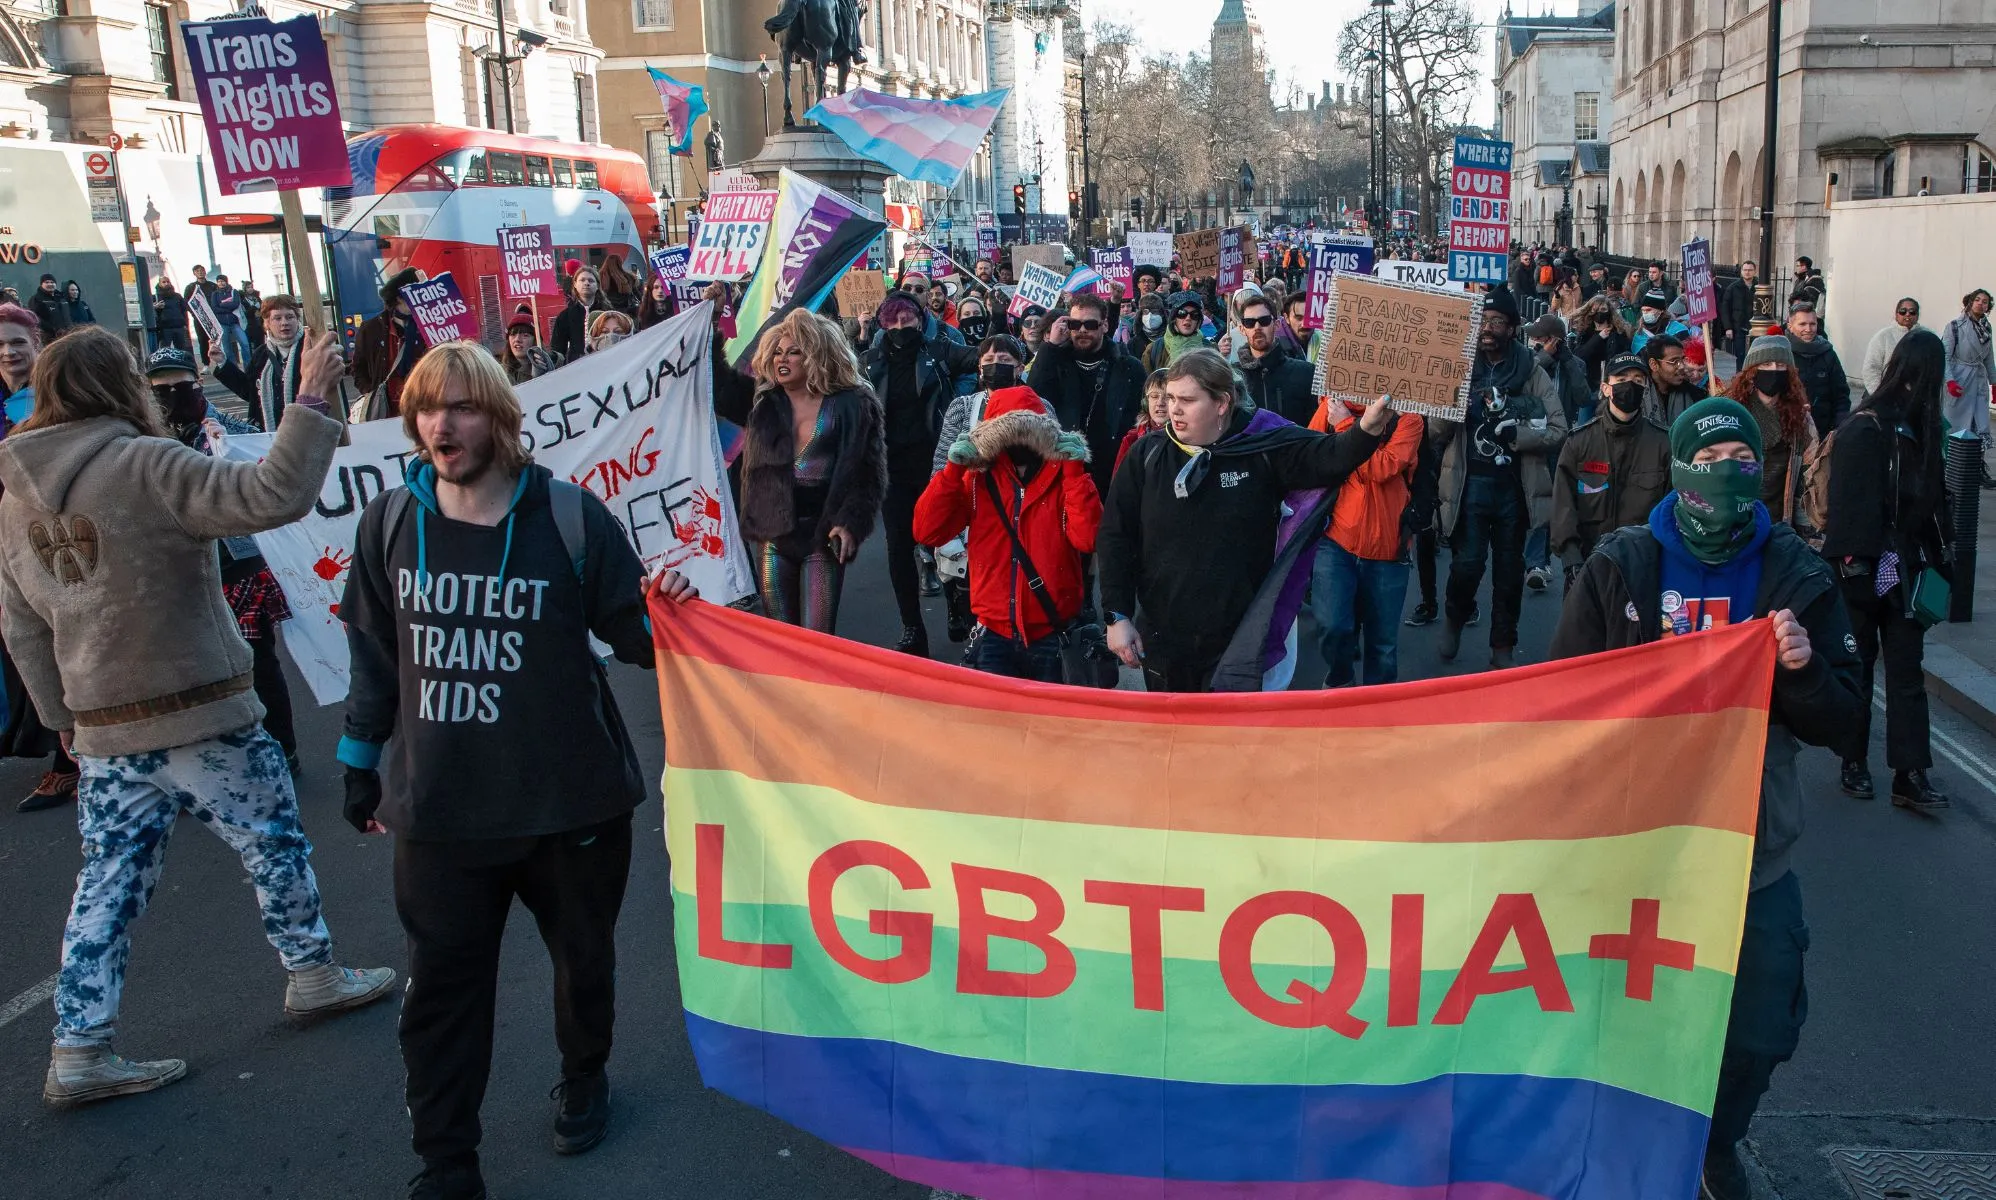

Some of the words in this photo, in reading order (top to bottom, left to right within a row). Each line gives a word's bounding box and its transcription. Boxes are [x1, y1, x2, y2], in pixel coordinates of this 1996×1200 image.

[188, 26, 297, 73] Trans
[207, 73, 332, 132] Rights
[110, 135, 119, 148] P
[220, 128, 300, 174] Now
[1458, 143, 1509, 166] WHERE'S
[1456, 171, 1503, 194] OUR
[709, 195, 773, 220] WAITING
[1453, 198, 1508, 222] GENDER
[499, 229, 541, 249] Trans
[700, 223, 760, 249] LISTS
[785, 210, 832, 268] NOT
[979, 232, 993, 240] Trans
[1221, 233, 1238, 249] Trans
[1454, 226, 1505, 248] REFORM
[505, 250, 553, 276] Rights
[652, 253, 685, 268] Trans
[693, 251, 750, 275] KILL
[931, 258, 950, 269] ights
[1092, 249, 1122, 264] Trans
[1220, 247, 1243, 270] Rights
[1314, 244, 1359, 270] Trans
[1455, 254, 1502, 281] BILL
[1683, 246, 1706, 269] Trans
[659, 262, 690, 280] Right
[1024, 264, 1063, 291] WAITING
[1095, 264, 1131, 281] Rights
[1220, 270, 1235, 287] Now
[1394, 265, 1448, 287] TRANS
[1686, 267, 1712, 294] Rights
[402, 282, 448, 306] Trans
[508, 275, 540, 295] Now
[1018, 280, 1056, 308] LISTS
[1096, 279, 1110, 294] No
[414, 298, 467, 325] Rights
[1340, 292, 1429, 325] TRANS
[1689, 293, 1708, 316] Now
[424, 323, 460, 345] Now
[1335, 315, 1433, 346] RIGHTS
[1333, 338, 1375, 364] ARE
[1378, 345, 1422, 374] NOT
[1426, 355, 1470, 380] FOR
[1697, 414, 1739, 431] UNISON
[398, 567, 550, 621] PROTECT
[409, 623, 523, 672] TRANS
[418, 678, 501, 724] KIDS
[694, 823, 1697, 1041] LGBTQIA+
